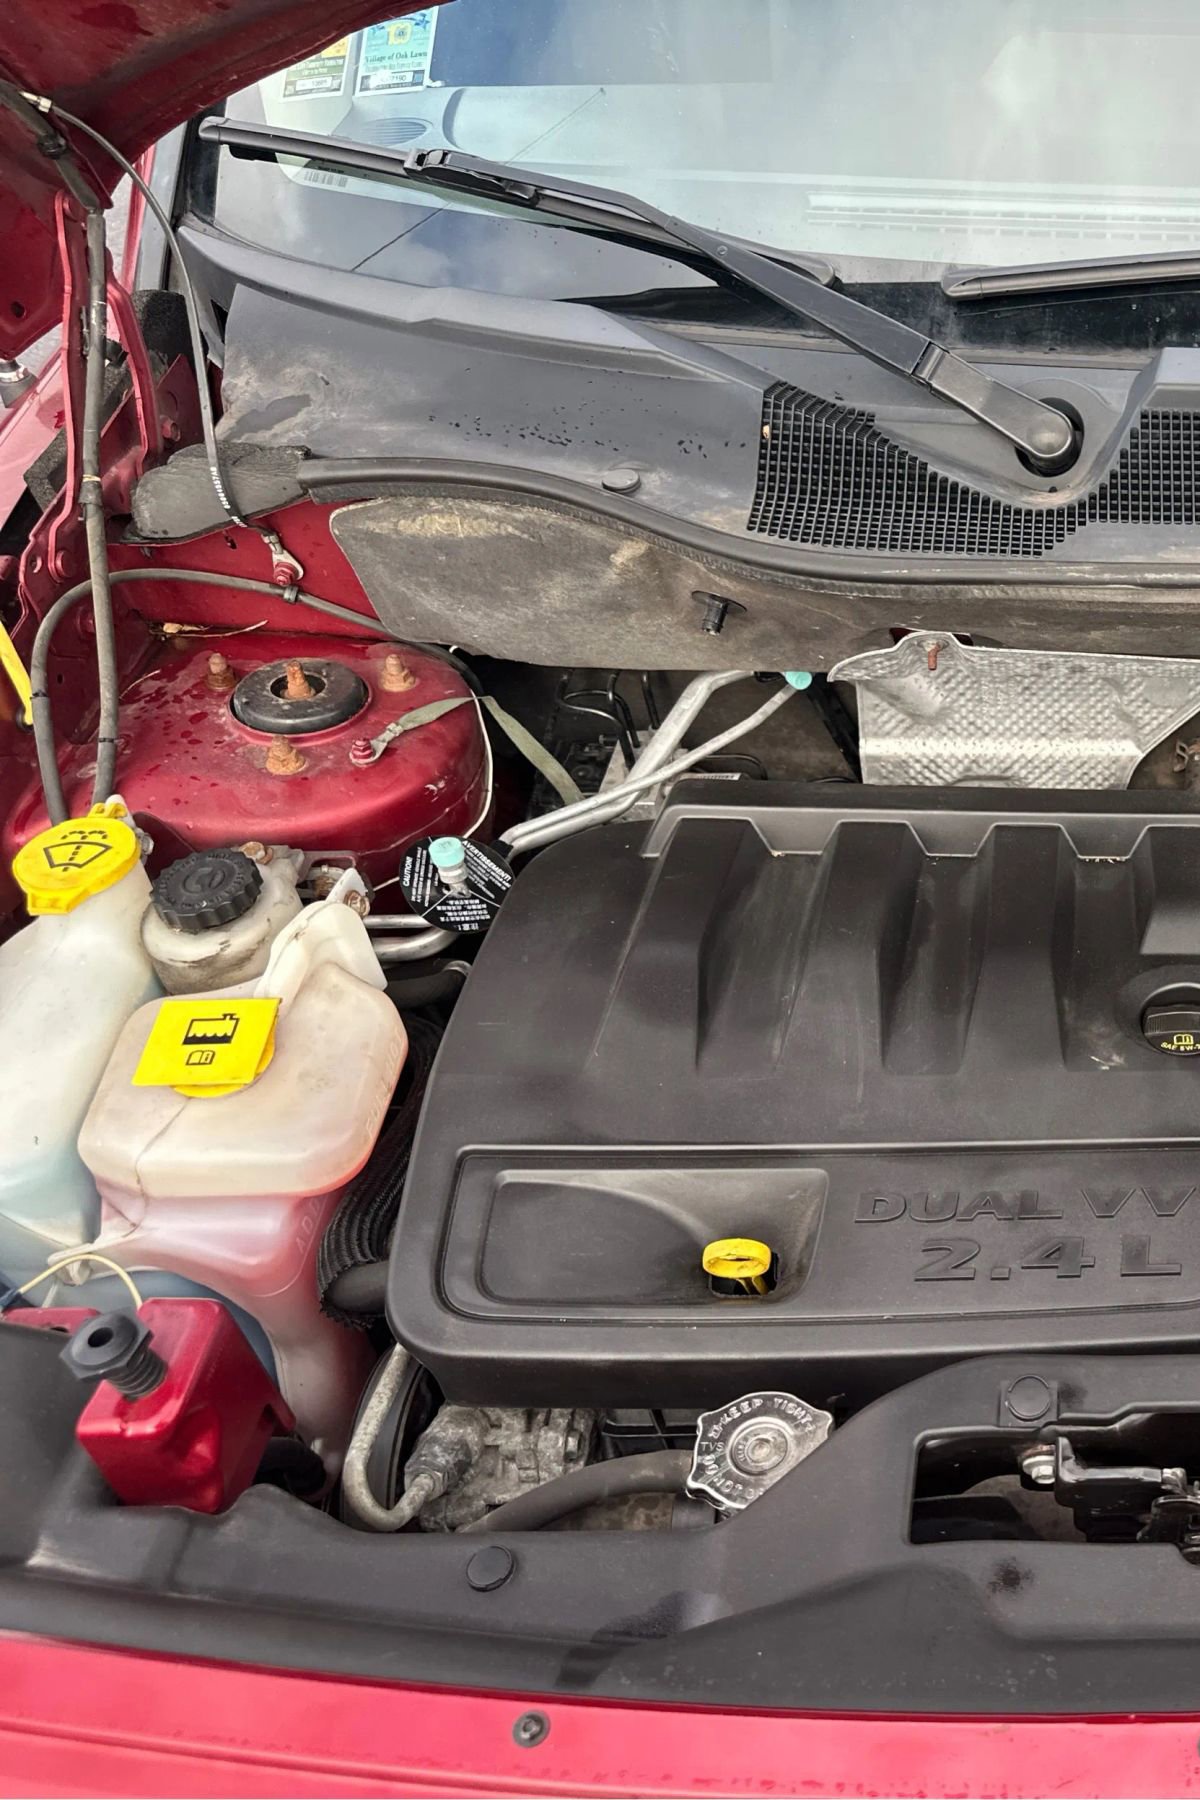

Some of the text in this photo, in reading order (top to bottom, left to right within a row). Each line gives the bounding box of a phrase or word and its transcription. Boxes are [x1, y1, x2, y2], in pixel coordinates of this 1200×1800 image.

[396, 51, 408, 59] Oak
[854, 1190, 1063, 1223] DUAL
[721, 1397, 814, 1425] KEEP TIGHT
[700, 1441, 726, 1452] TVS
